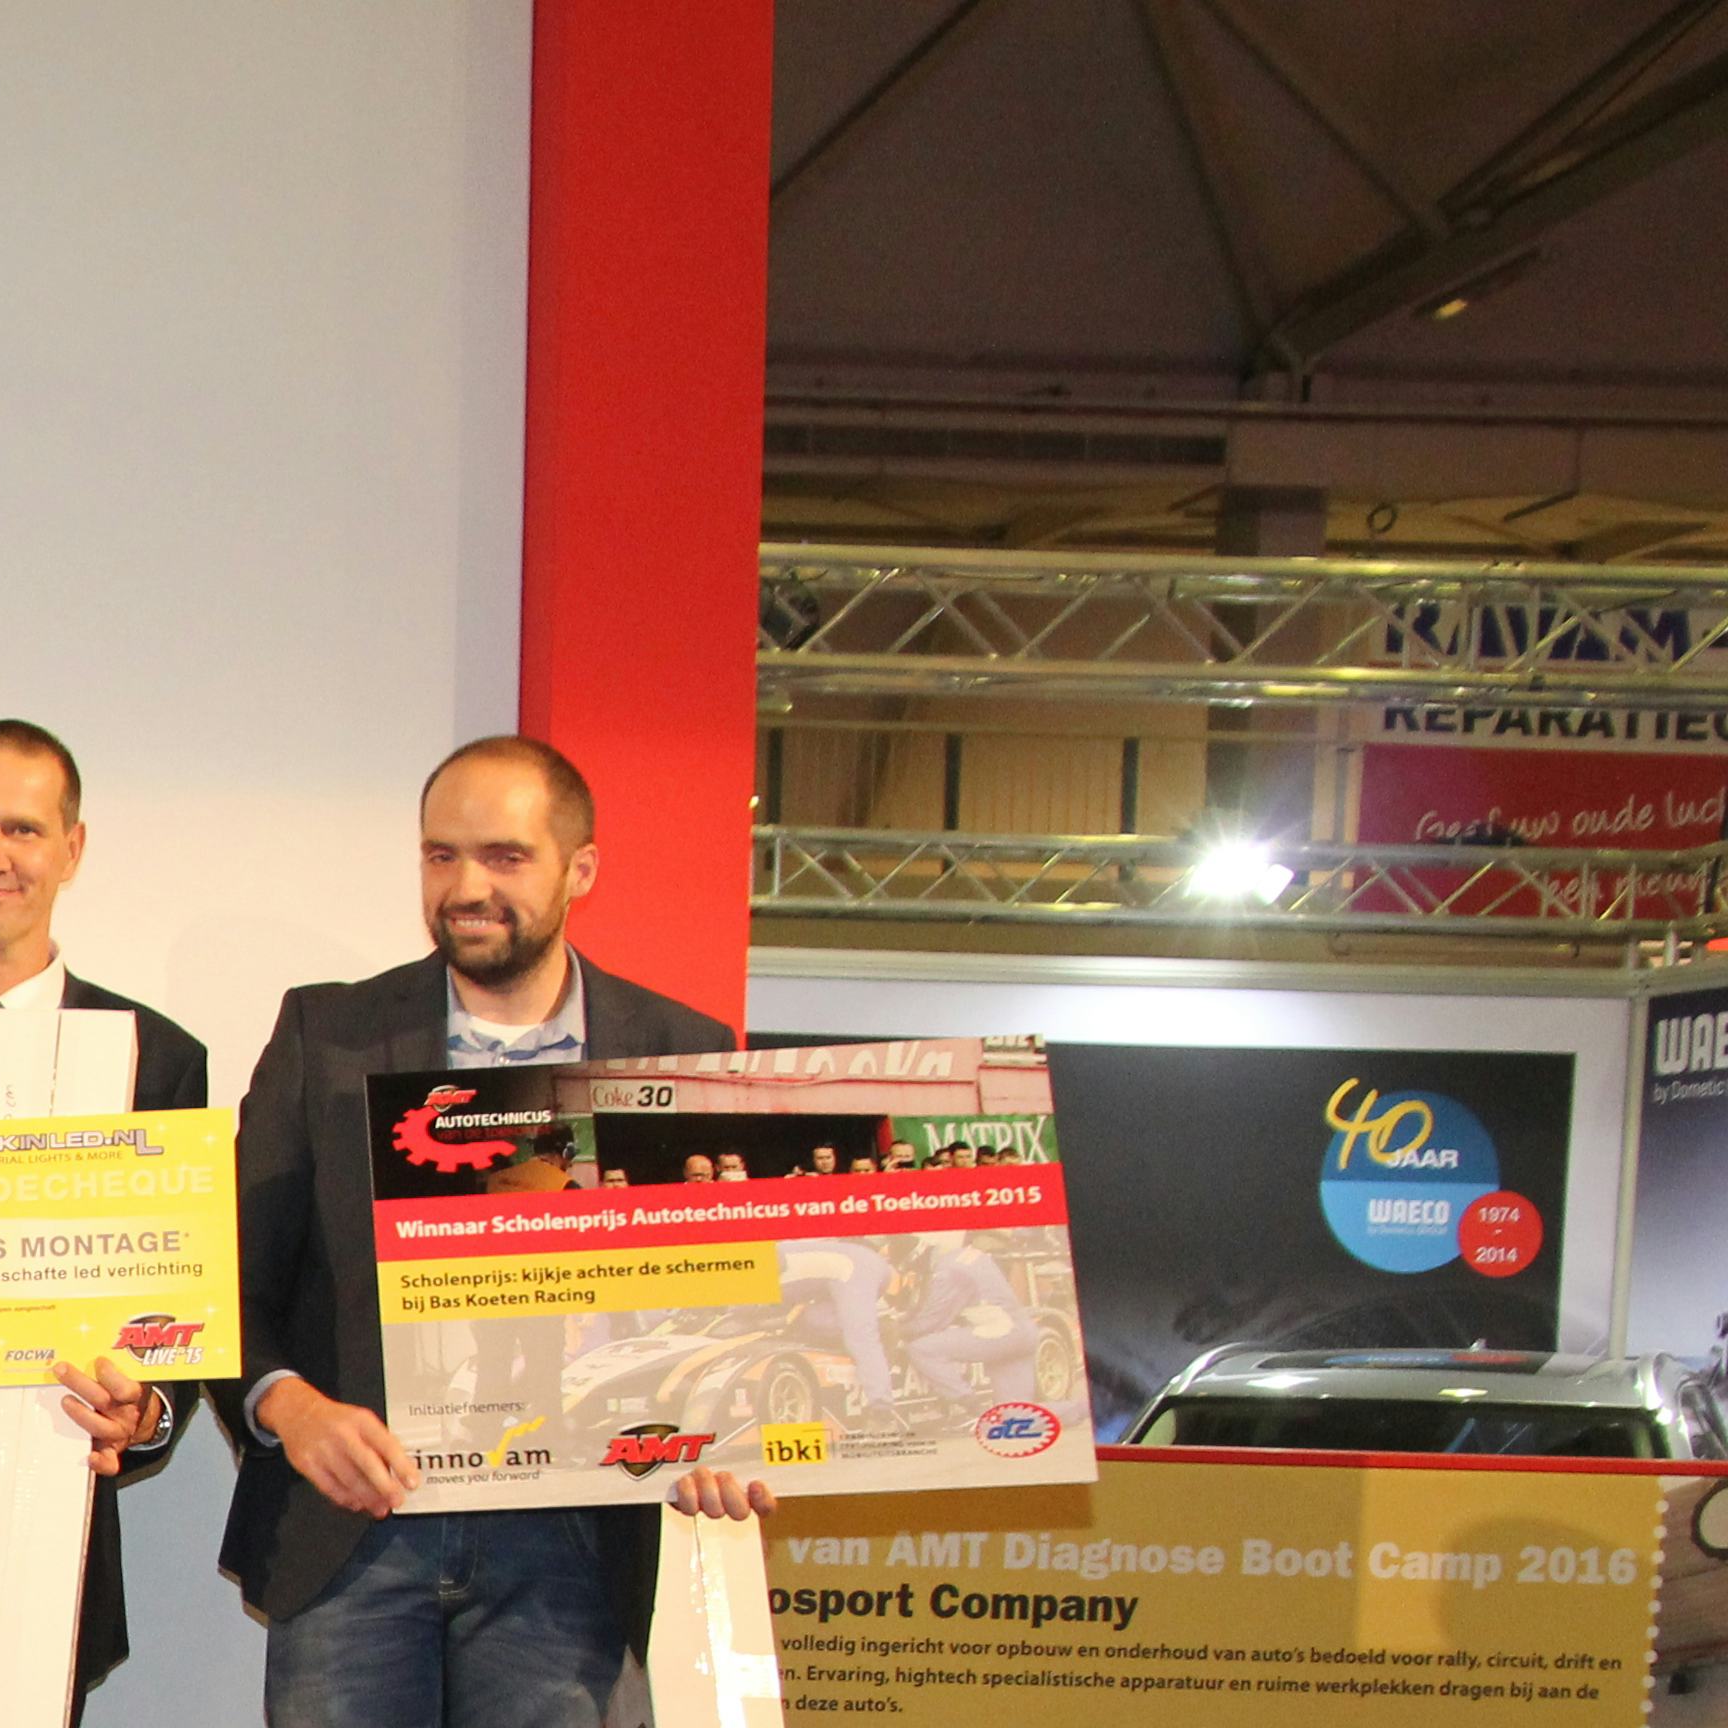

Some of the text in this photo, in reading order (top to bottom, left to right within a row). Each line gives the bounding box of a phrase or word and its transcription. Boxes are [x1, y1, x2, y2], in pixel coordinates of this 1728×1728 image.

[1572, 794, 1654, 836] oude
[592, 1085, 675, 1108] Coke 30
[1654, 1079, 1723, 1105] by Dometic
[434, 1109, 552, 1130] AUTOTECHNICUS
[1326, 1077, 1434, 1169] 40
[27, 1152, 72, 1164] LIGHTS
[75, 1151, 84, 1162] &
[87, 1150, 124, 1161] MORE
[1387, 1149, 1459, 1168] JAAR
[396, 1185, 1042, 1239] Winnaar Scholenprijs Autotechnicus van de Toekomst 2015
[1368, 1199, 1451, 1225] WAECO
[1478, 1206, 1520, 1223] 1974
[1476, 1246, 1518, 1263] 2014
[73, 1264, 101, 1281] led
[107, 1261, 204, 1280] verlichting
[401, 1257, 755, 1290] Scholenprijs: kijkje achter de schermen
[402, 1288, 595, 1313] bij Bas Koeten Racing
[112, 1321, 205, 1351] AMT
[4, 1349, 56, 1361] FOCWA
[141, 1347, 177, 1367] LIVE
[408, 1401, 527, 1417] Initiatiefnemers:
[599, 1431, 716, 1466] AMT
[765, 1438, 823, 1463] ibki
[426, 1468, 542, 1486] moves you forward
[788, 1530, 1638, 1589] van AMT Diagnose Boot Camp 2016
[769, 1584, 1139, 1631] osport Company
[781, 1635, 1622, 1671] volledig ingericht voor opbouw en onderhoud van auto's bedoeld voor rally, circuit, drift en
[806, 1666, 891, 1688] Ervaring,
[895, 1666, 977, 1688] hightech
[982, 1669, 1116, 1690] specialistische
[1121, 1674, 1225, 1693] apparatuur
[1229, 1679, 1252, 1692] en
[1257, 1676, 1310, 1694] ruime
[1315, 1677, 1435, 1698] werkplekken
[1440, 1680, 1506, 1701] dragen
[1510, 1681, 1535, 1702] bij
[1538, 1686, 1572, 1700] aan
[1576, 1684, 1600, 1701] de
[795, 1694, 904, 1713] deze auto's.
